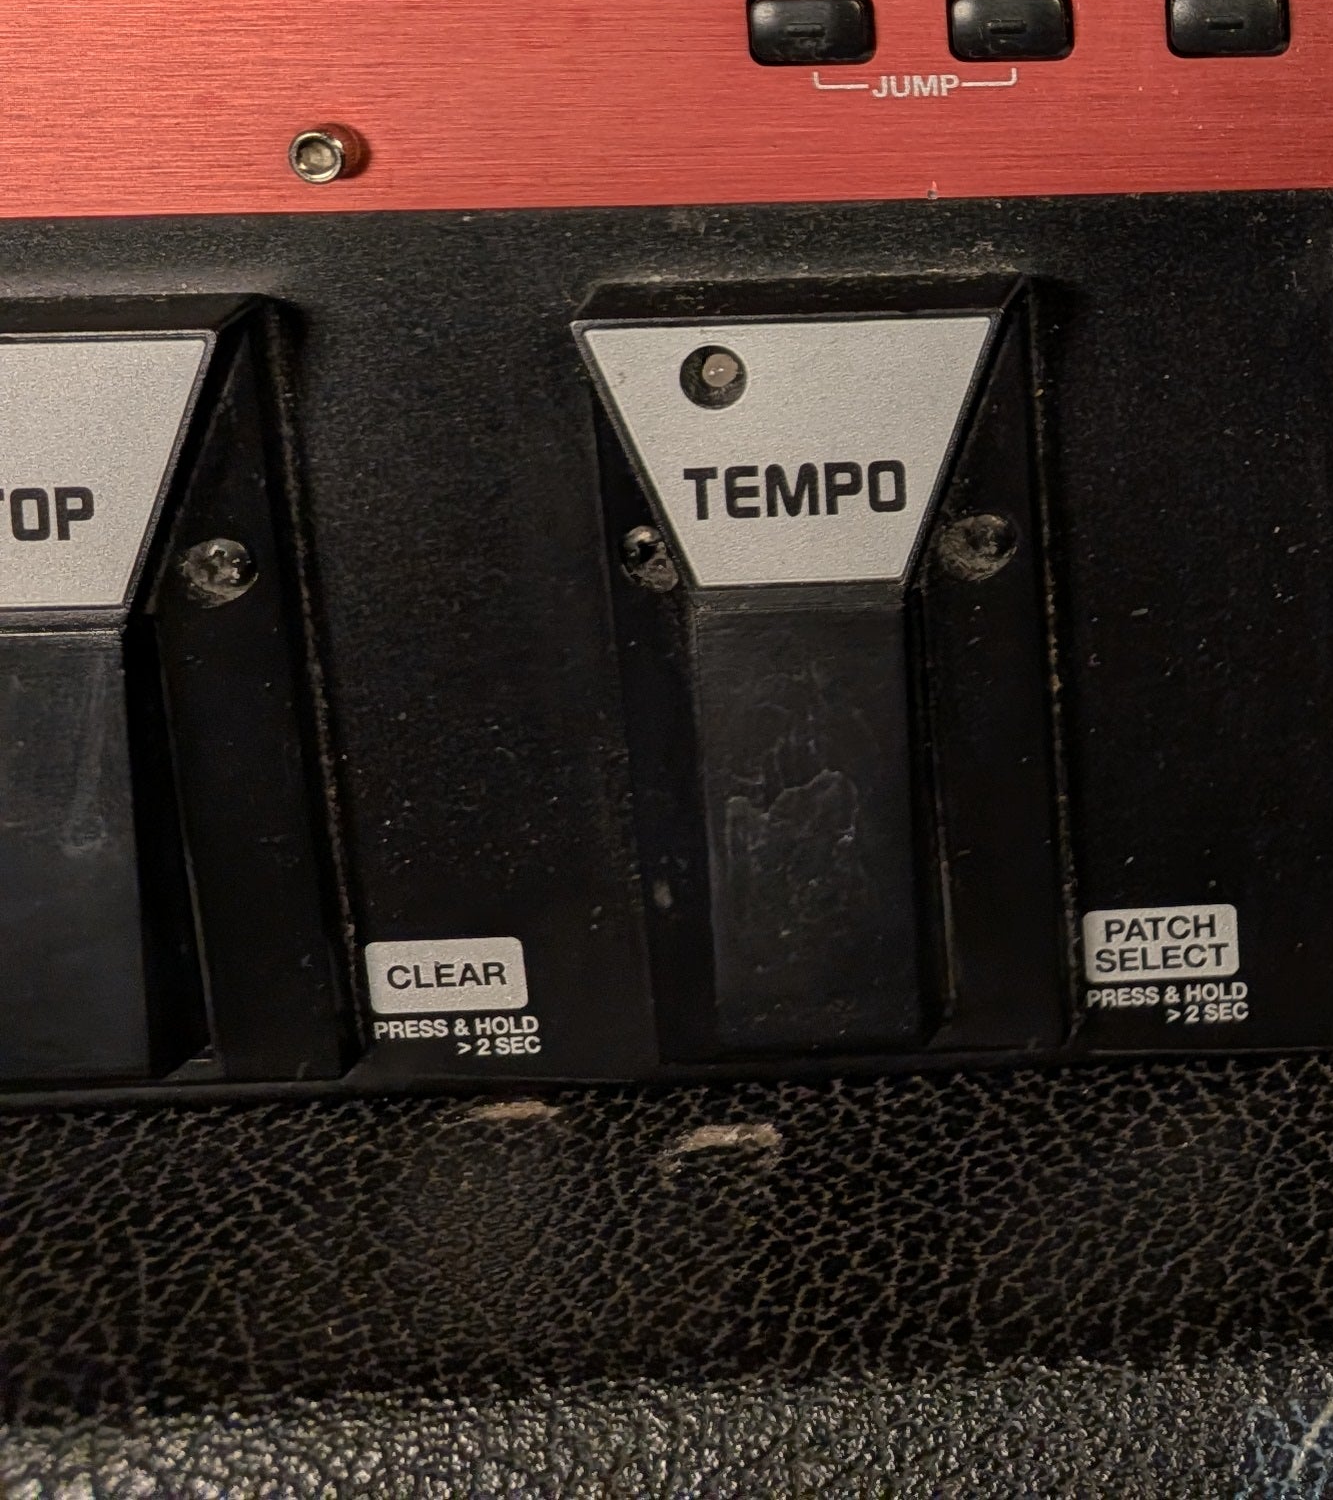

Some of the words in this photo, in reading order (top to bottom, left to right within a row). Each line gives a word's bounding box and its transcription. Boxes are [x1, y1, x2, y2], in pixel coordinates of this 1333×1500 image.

[872, 75, 960, 98] JUMP
[683, 459, 907, 522] TEMPO
[0, 487, 94, 541] OP
[1105, 914, 1216, 943] PATCH
[1096, 943, 1229, 972] SELECT
[387, 961, 506, 989] CLEAR
[1087, 986, 1160, 1008] PRESS
[1164, 986, 1180, 1004] &
[1185, 982, 1248, 1002] HOLD
[1185, 1005, 1200, 1023] 2
[1204, 1002, 1248, 1022] SEC
[374, 1019, 448, 1039] PRESS
[454, 1018, 470, 1036] &
[475, 1016, 539, 1035] HOLD
[476, 1039, 491, 1056] 2
[495, 1036, 541, 1055] SEC
